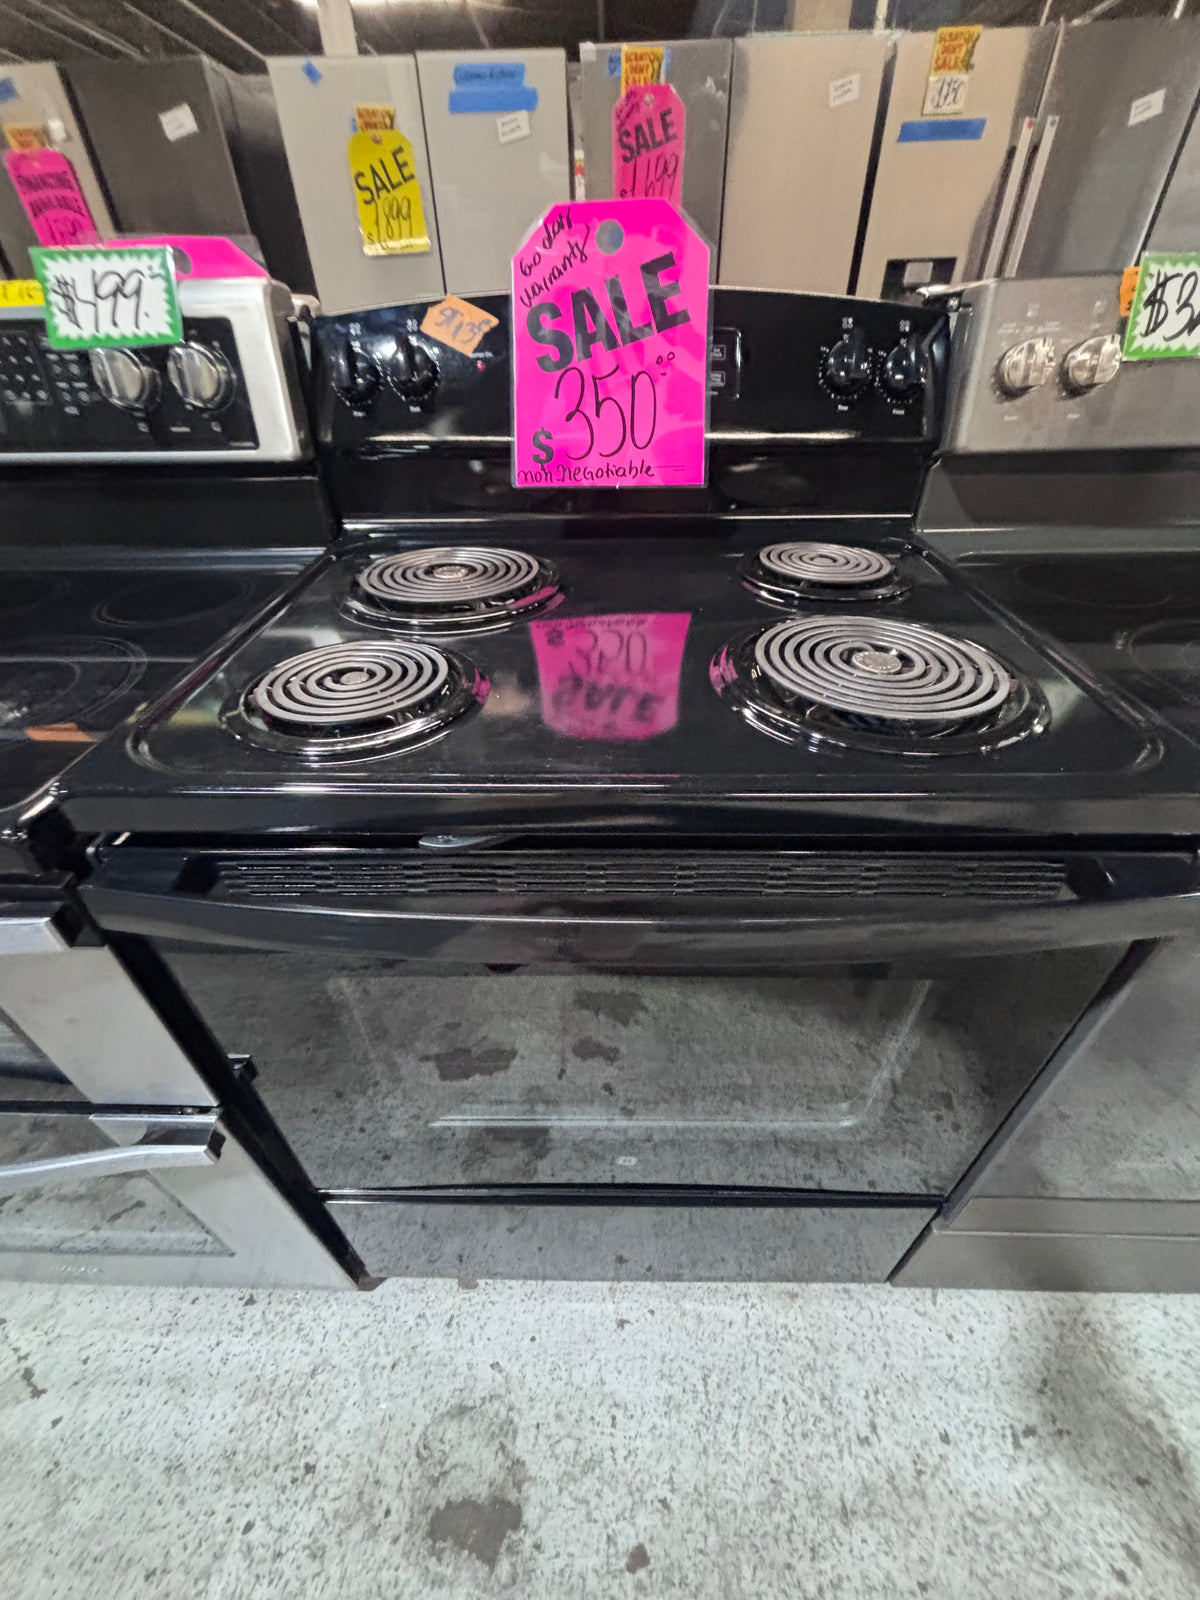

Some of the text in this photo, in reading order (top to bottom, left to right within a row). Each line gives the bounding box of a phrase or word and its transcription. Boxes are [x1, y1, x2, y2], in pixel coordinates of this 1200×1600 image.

[618, 108, 677, 163] SALE
[354, 145, 415, 205] SALE
[527, 251, 691, 373] SALE
[532, 427, 555, 471] $
[554, 365, 657, 461] 350
[517, 469, 553, 483] non
